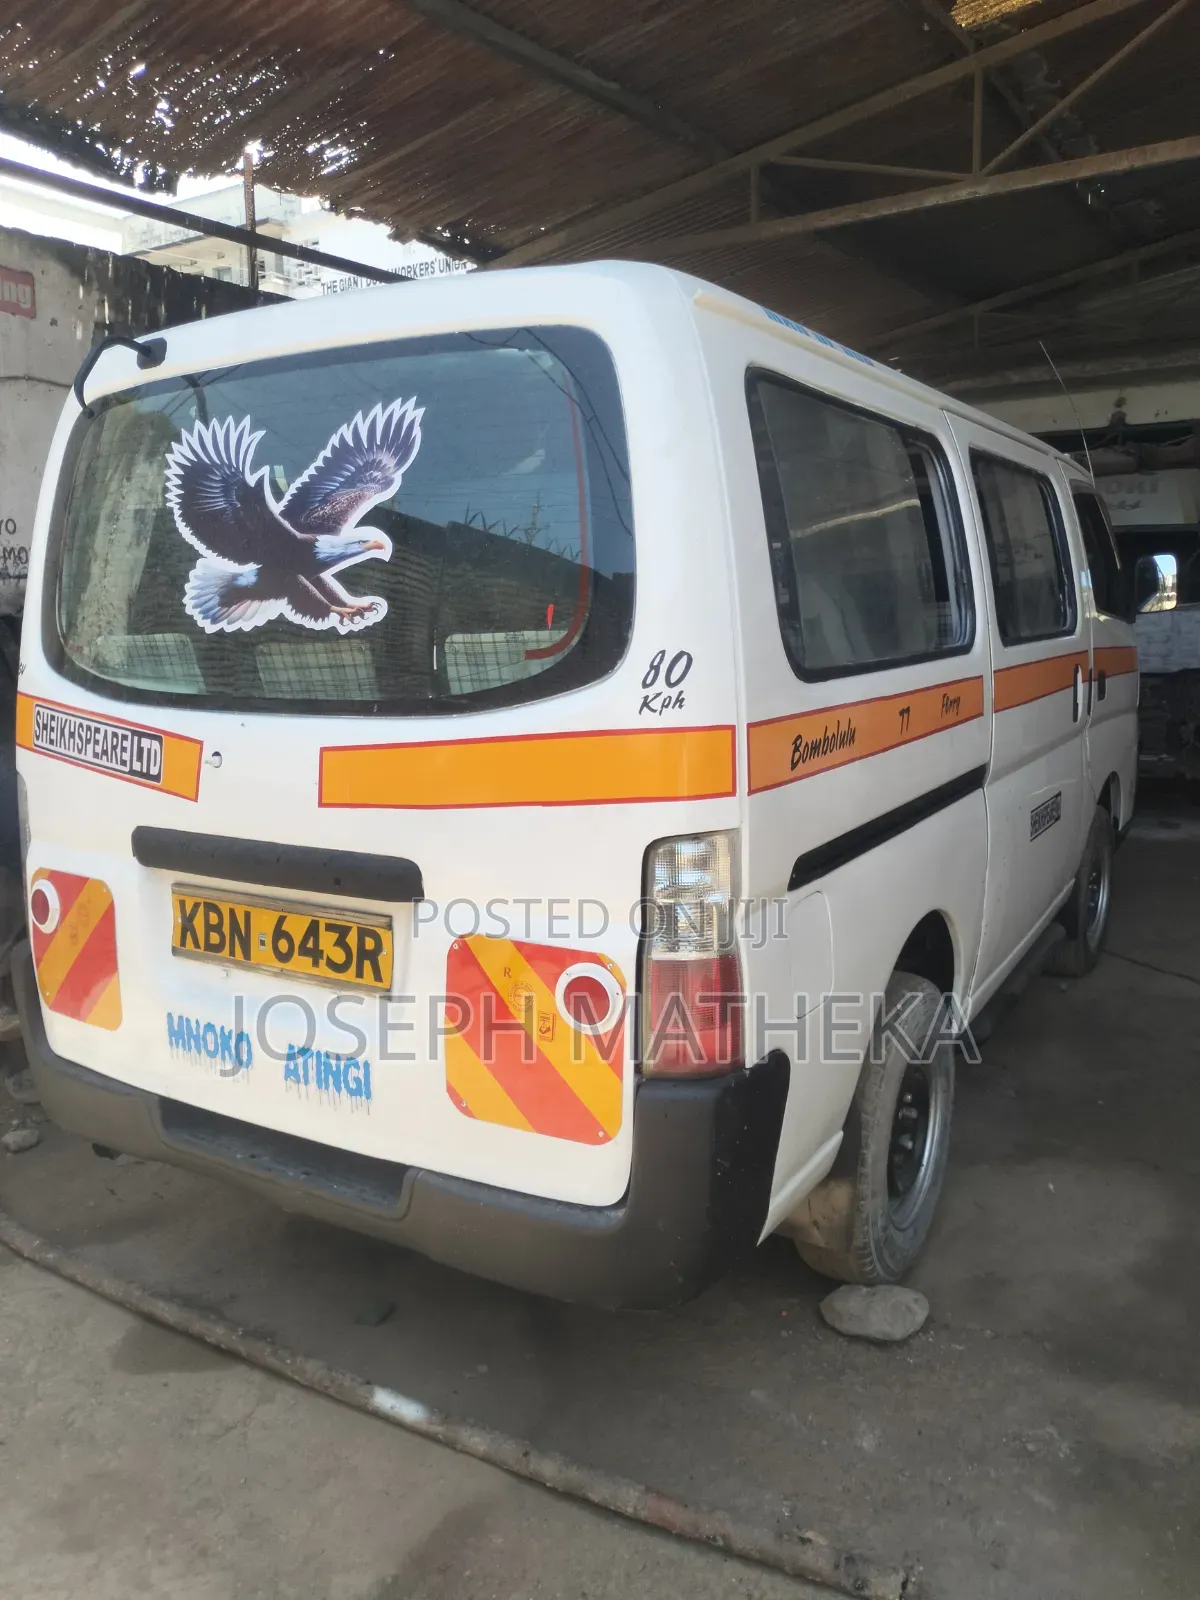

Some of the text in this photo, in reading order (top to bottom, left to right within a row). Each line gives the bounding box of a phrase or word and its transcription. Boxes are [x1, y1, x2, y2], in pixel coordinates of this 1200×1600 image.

[0, 280, 32, 309] ng
[321, 279, 338, 295] THE
[641, 649, 694, 690] 80
[638, 690, 686, 717] Kph
[34, 709, 161, 776] SHEIKHSPEARE LTD
[790, 717, 857, 772] Bombolulu
[178, 899, 384, 983] KBN 643R
[503, 966, 512, 979] R
[284, 1043, 373, 1102] ATINGI
